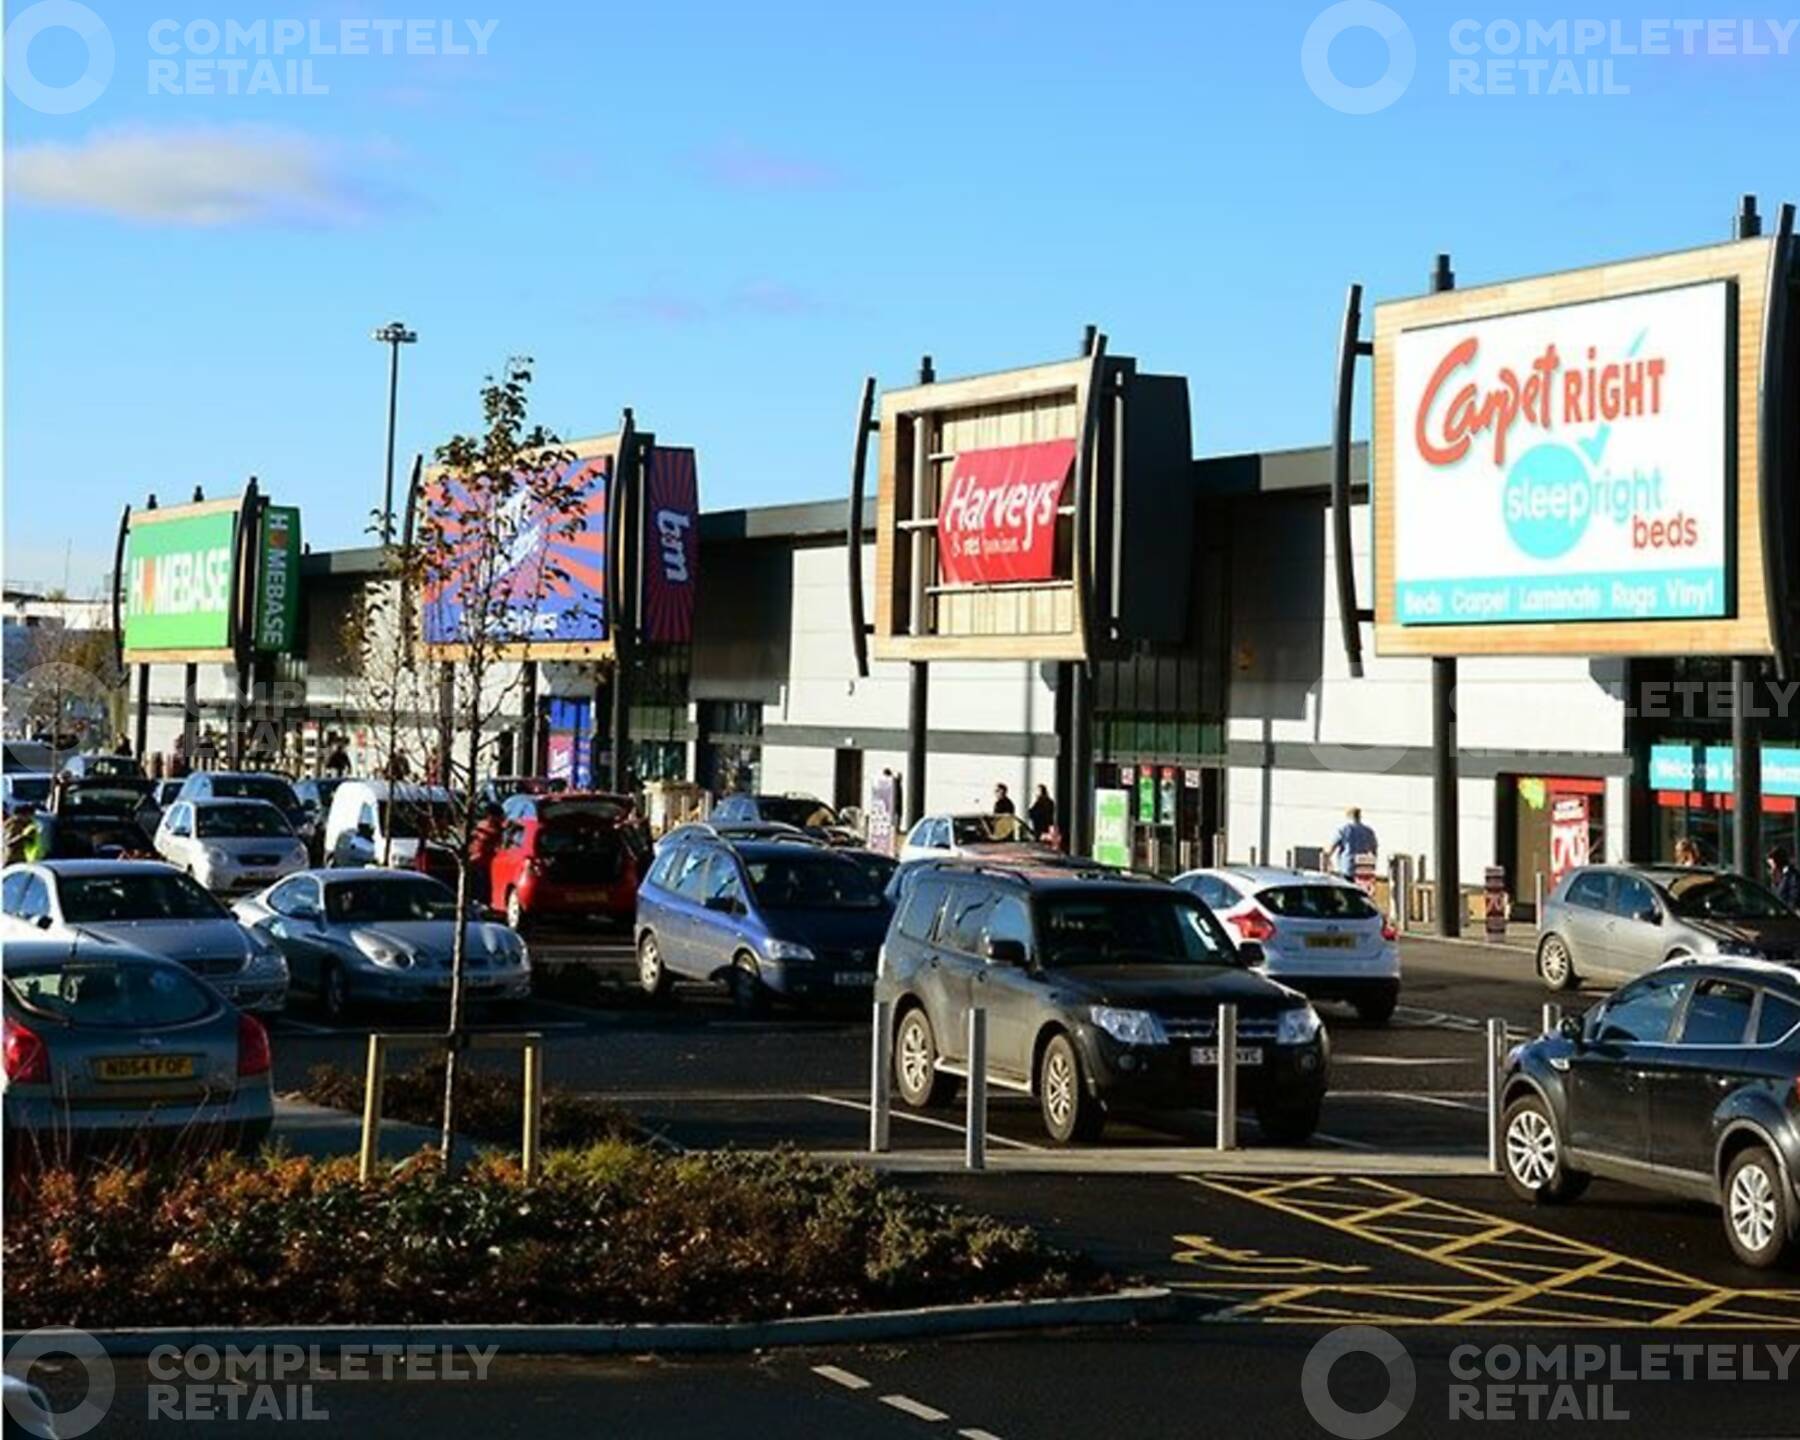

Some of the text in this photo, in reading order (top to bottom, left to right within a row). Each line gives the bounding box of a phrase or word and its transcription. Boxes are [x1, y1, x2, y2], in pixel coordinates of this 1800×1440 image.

[944, 475, 1060, 551] Harveys
[1632, 511, 1698, 549] beds
[129, 547, 231, 616] HOMEBASE
[264, 513, 289, 645] HOMEBASE
